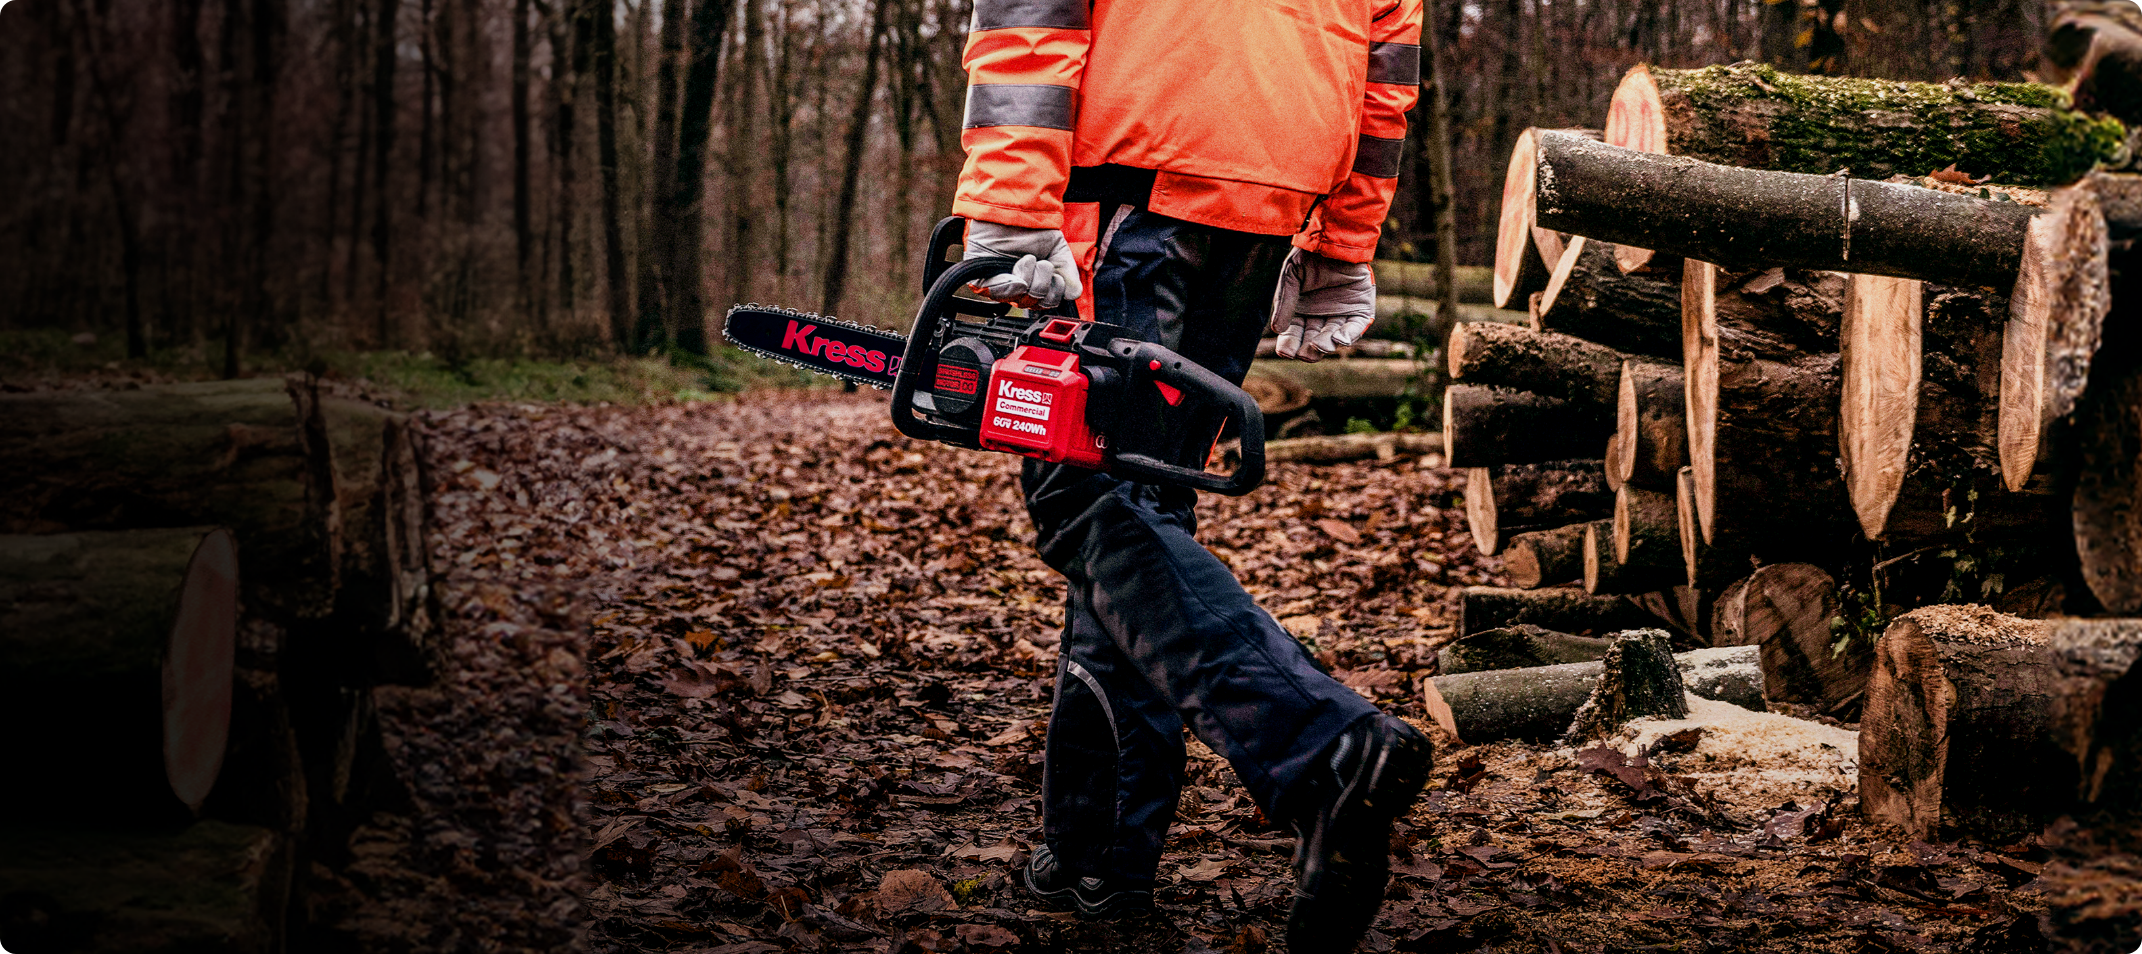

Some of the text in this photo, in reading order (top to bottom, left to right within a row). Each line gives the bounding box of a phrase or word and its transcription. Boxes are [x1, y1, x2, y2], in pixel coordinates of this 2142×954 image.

[781, 319, 887, 373] Kress
[998, 379, 1042, 403] Kress
[999, 401, 1045, 417] Commercial
[1012, 420, 1047, 436] 240Wh
